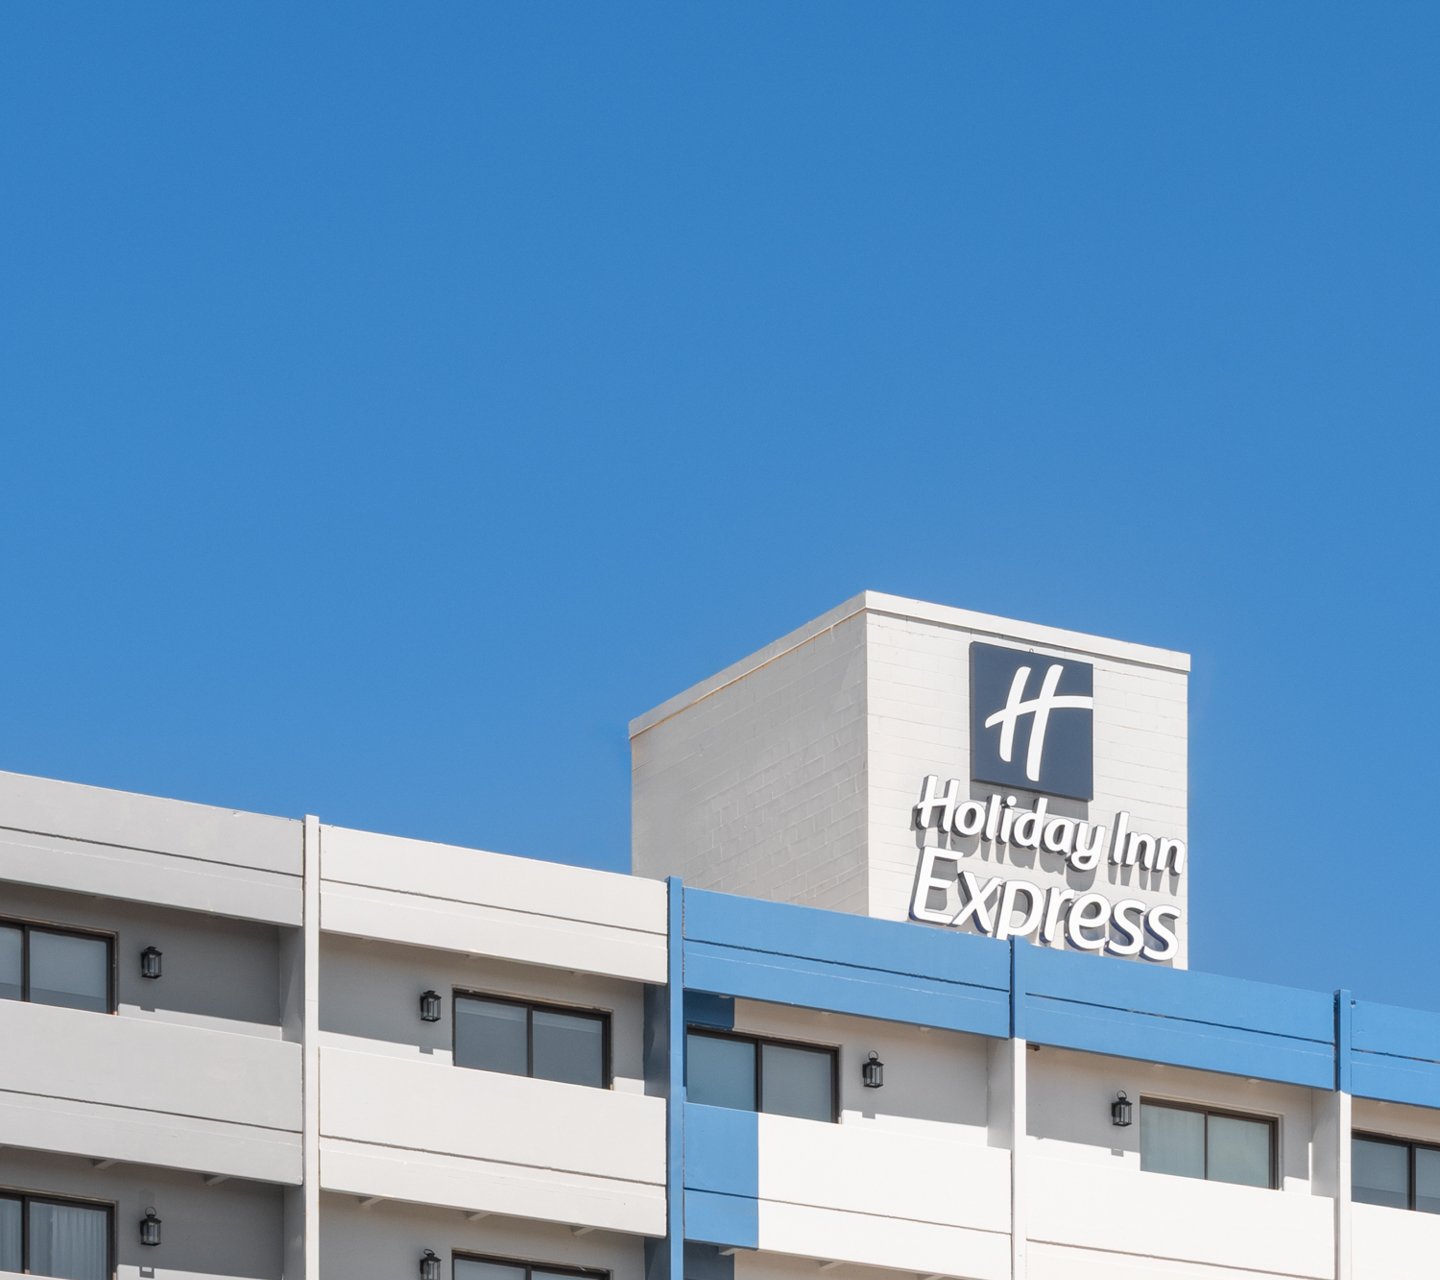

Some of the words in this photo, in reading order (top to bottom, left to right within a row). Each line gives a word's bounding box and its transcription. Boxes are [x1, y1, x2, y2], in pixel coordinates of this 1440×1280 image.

[916, 775, 1107, 871] Holiday
[1110, 811, 1185, 875] Inn
[911, 845, 1182, 962] Express
